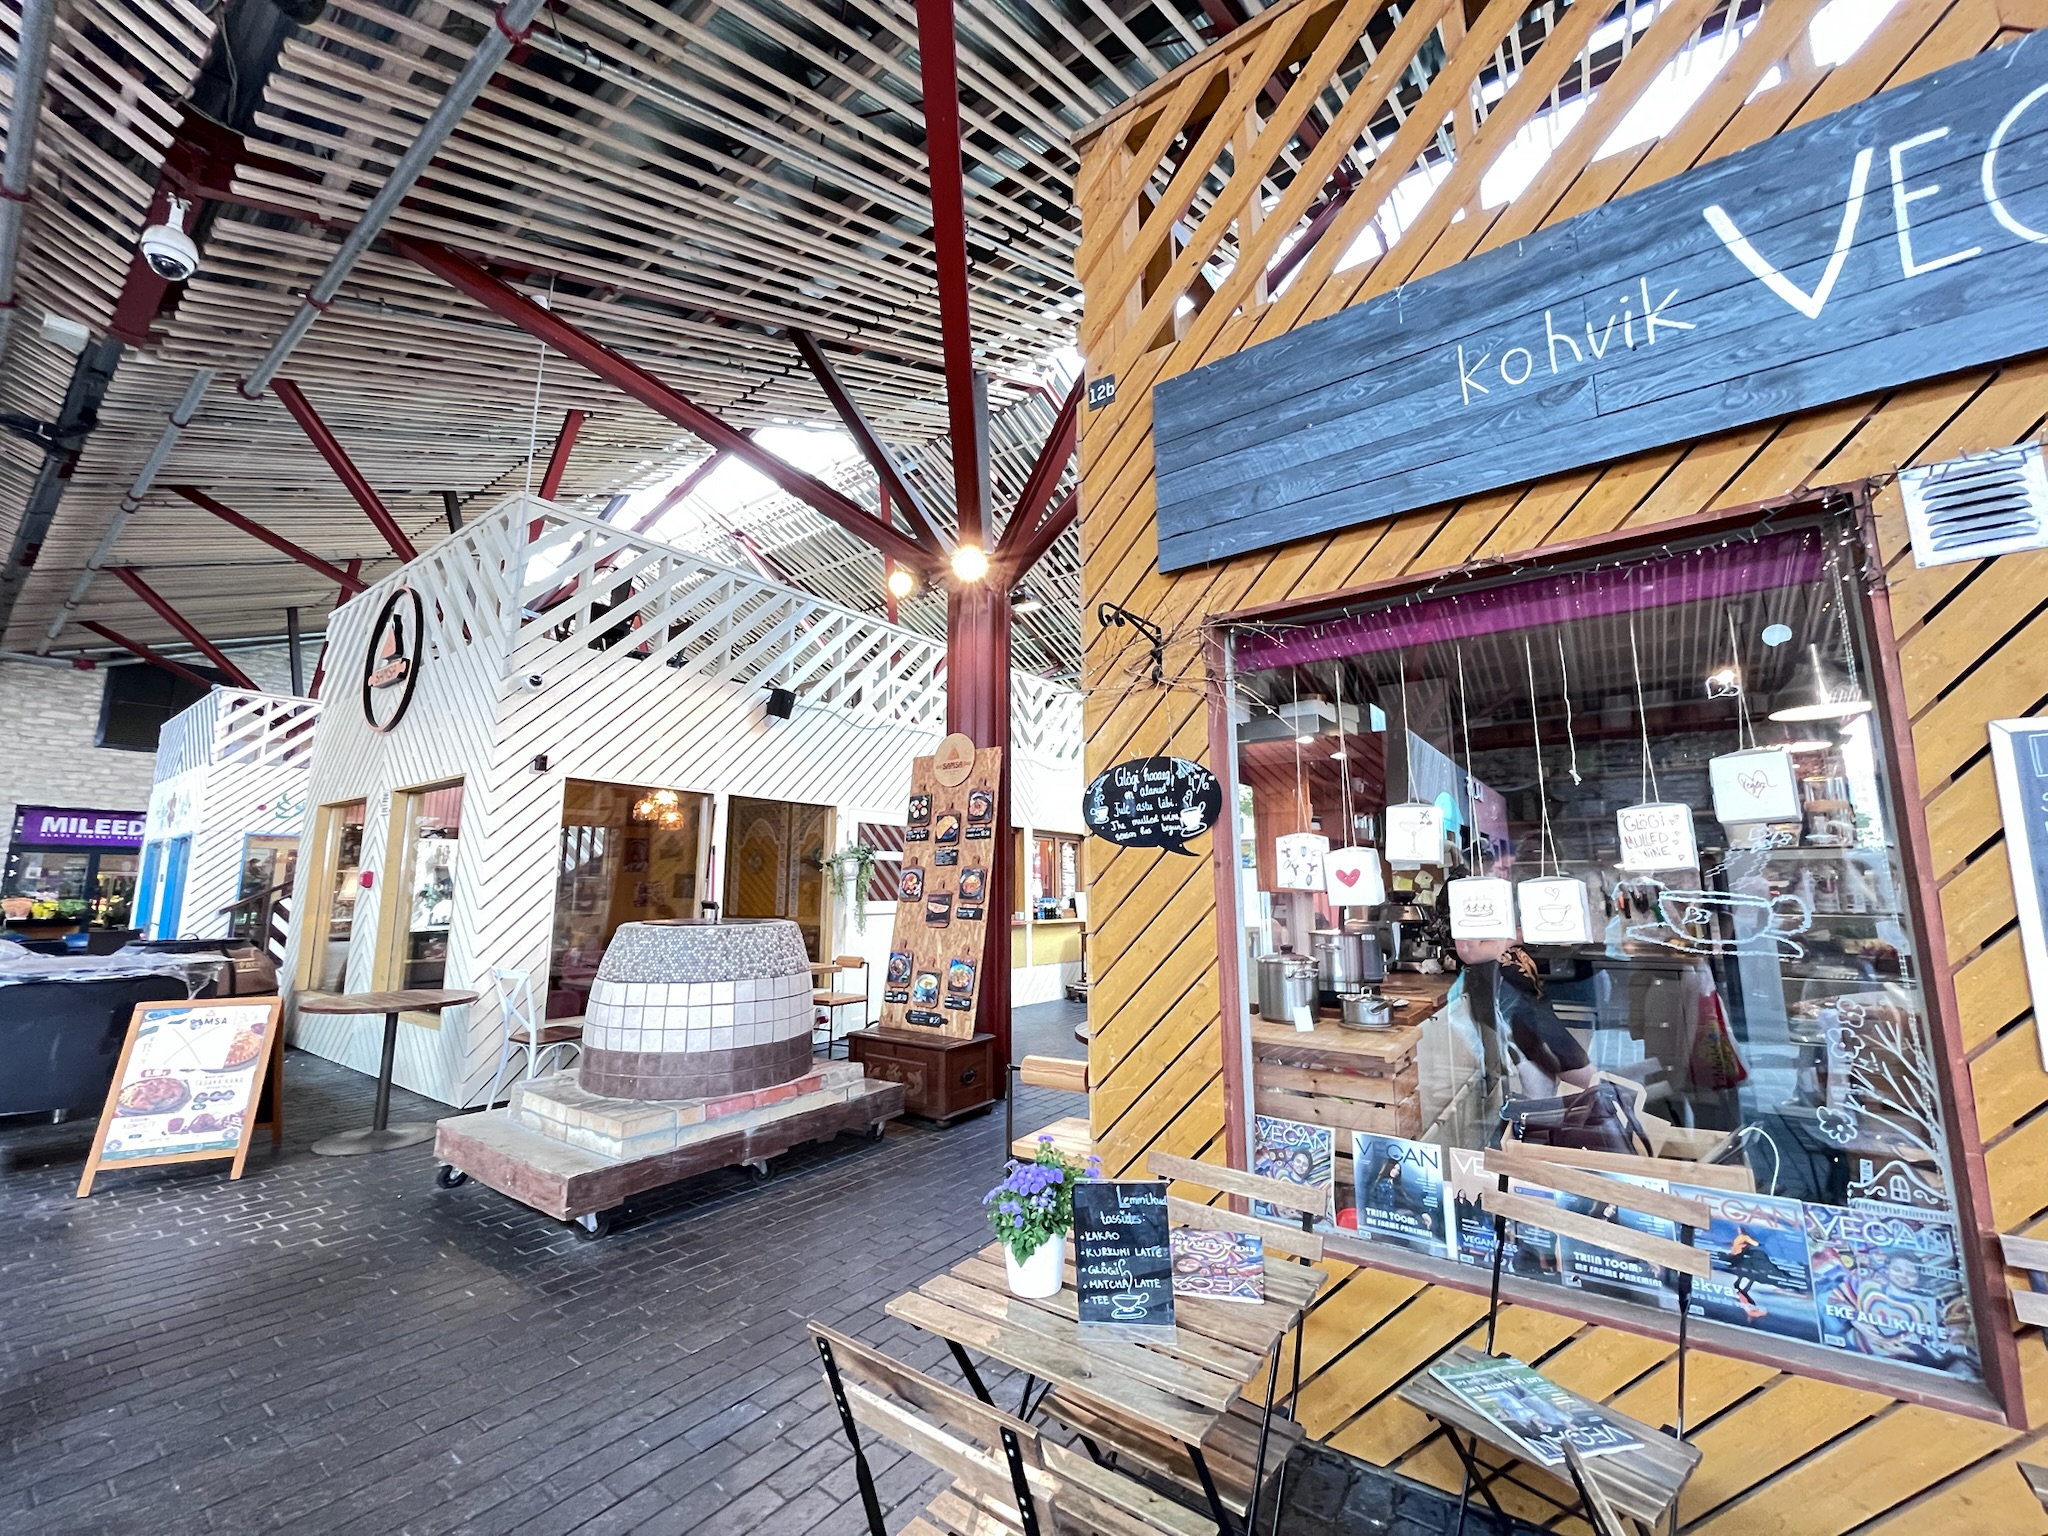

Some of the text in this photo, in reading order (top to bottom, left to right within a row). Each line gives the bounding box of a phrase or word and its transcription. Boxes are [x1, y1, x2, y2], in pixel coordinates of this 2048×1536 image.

[1457, 276, 1697, 406] kohvik
[1089, 382, 1115, 405] 12b
[1114, 766, 1140, 792] Glögi
[1110, 811, 1180, 831] The mulled wine
[1115, 831, 1137, 841] season
[1140, 825, 1152, 835] has
[1624, 831, 1669, 850] MULLED
[1257, 1120, 1329, 1153] VEGAN
[1355, 1137, 1438, 1169] VEGAN
[1365, 1207, 1388, 1219] TRIIN
[1084, 1230, 1120, 1241] KAKAO
[1085, 1245, 1163, 1258] KURKUMI LATTE
[1573, 1251, 1602, 1265] TRIIN
[1089, 1278, 1161, 1290] MATCHA LATTE
[1090, 1295, 1110, 1305] TEE
[1825, 1304, 1855, 1320] EKE
